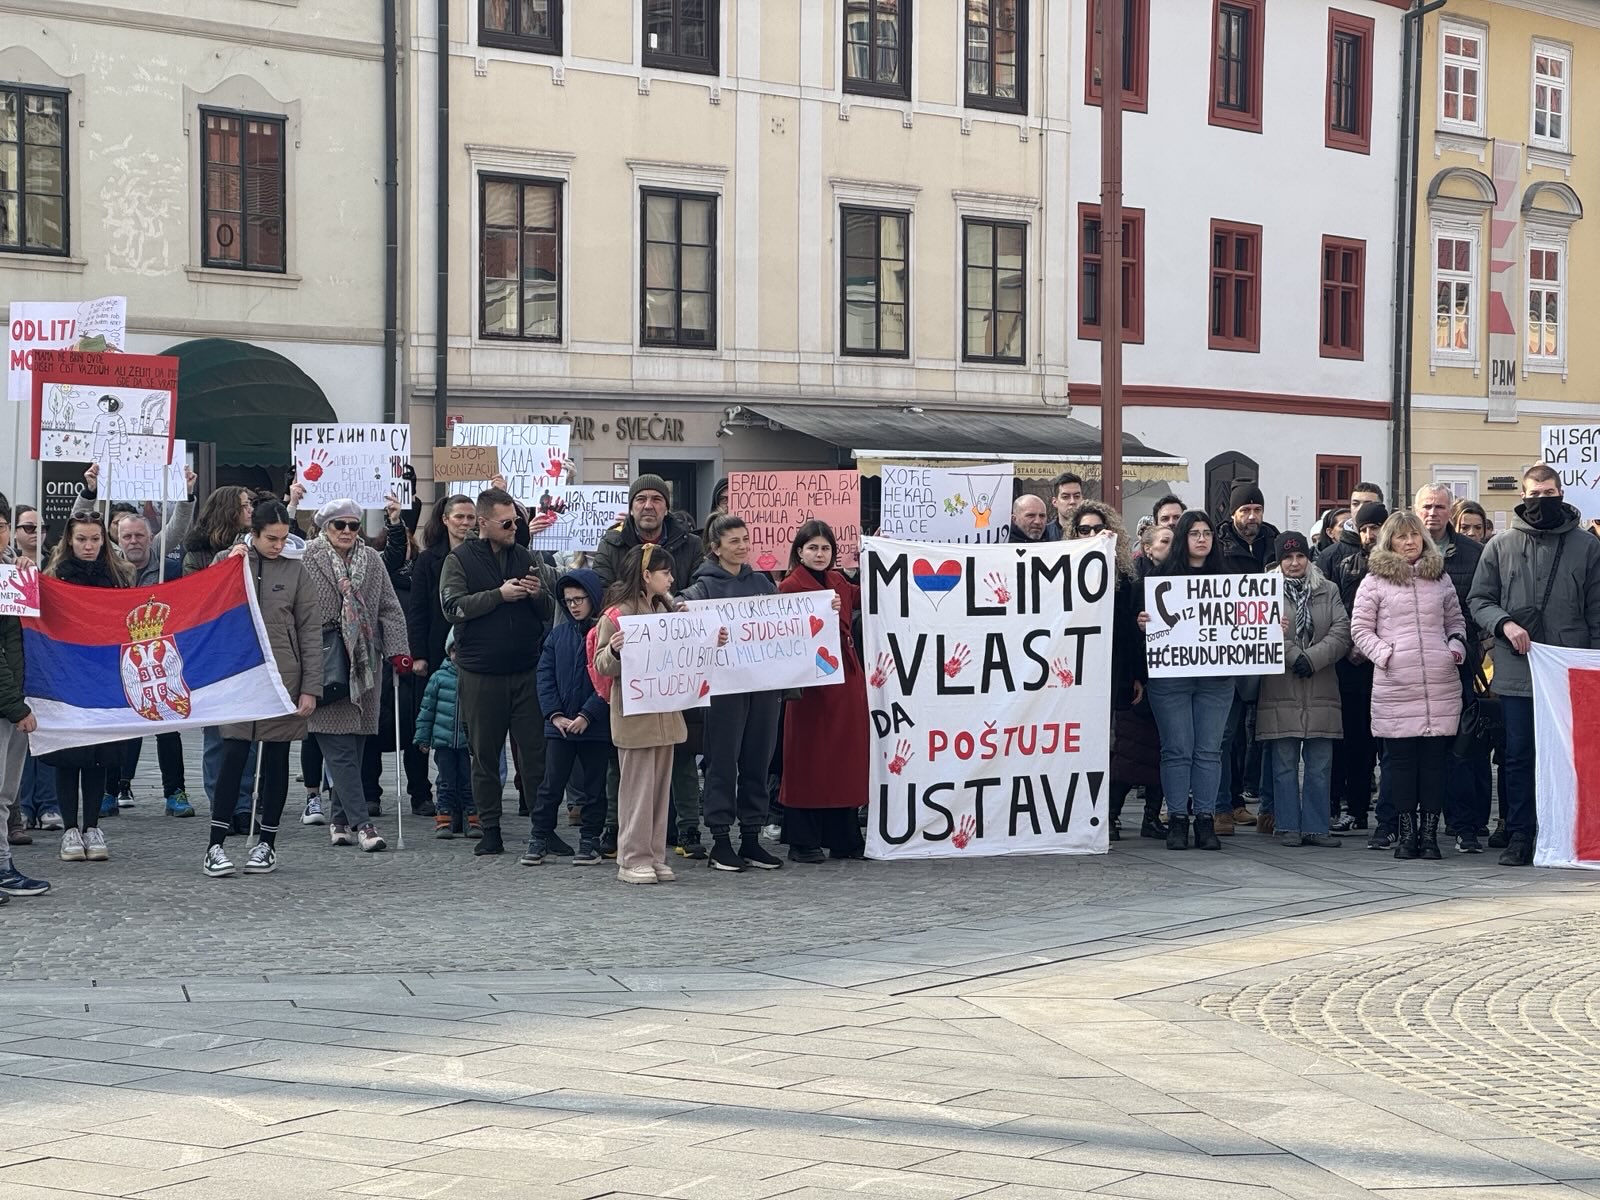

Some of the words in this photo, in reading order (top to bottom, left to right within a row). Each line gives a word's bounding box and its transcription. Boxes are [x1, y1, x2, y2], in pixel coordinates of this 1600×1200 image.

[79, 363, 110, 375] VAZDUH
[1492, 359, 1516, 386] PAM
[496, 425, 538, 445] ПРЕКО
[541, 425, 560, 445] ЈЕ
[616, 412, 685, 442] SVEČAR
[390, 428, 408, 451] СУ
[450, 447, 486, 460] STOP
[500, 447, 534, 473] КАДА
[1545, 447, 1568, 463] DA
[796, 474, 832, 492] КАД
[839, 473, 860, 491] БИ
[884, 468, 931, 486] ХОЋЕ
[1558, 469, 1588, 486] UK
[46, 481, 86, 495] orno
[110, 479, 185, 499] СЛОВЕНЈИ
[884, 487, 936, 504] НЕКАД
[730, 491, 799, 510] ПОСТОЈАЛА
[807, 491, 851, 506] МЕРНА
[883, 504, 937, 518] НЕШТО
[796, 509, 815, 524] ЗА
[881, 519, 904, 534] ДА
[909, 519, 928, 533] СЕ
[833, 524, 858, 541] ИЛА
[1186, 578, 1231, 600] HALO
[1238, 575, 1277, 597] ĆACI
[1181, 606, 1196, 621] IZ
[1199, 601, 1281, 626] MARIBORA
[625, 623, 652, 644] ZA
[658, 618, 668, 642] 9
[739, 617, 805, 643] STUDENTI
[1198, 627, 1218, 642] SE
[1230, 624, 1268, 641] ČUJE
[656, 649, 675, 673] JA
[737, 642, 808, 666] MILICAJCI
[887, 626, 1102, 696] VLAST
[1146, 642, 1283, 669] #ĆEBUDUPROMENE
[629, 672, 705, 700] STUDENT
[870, 701, 915, 739] DA
[928, 719, 1081, 762] POŠTUJE
[879, 771, 1105, 845] USTAV!
